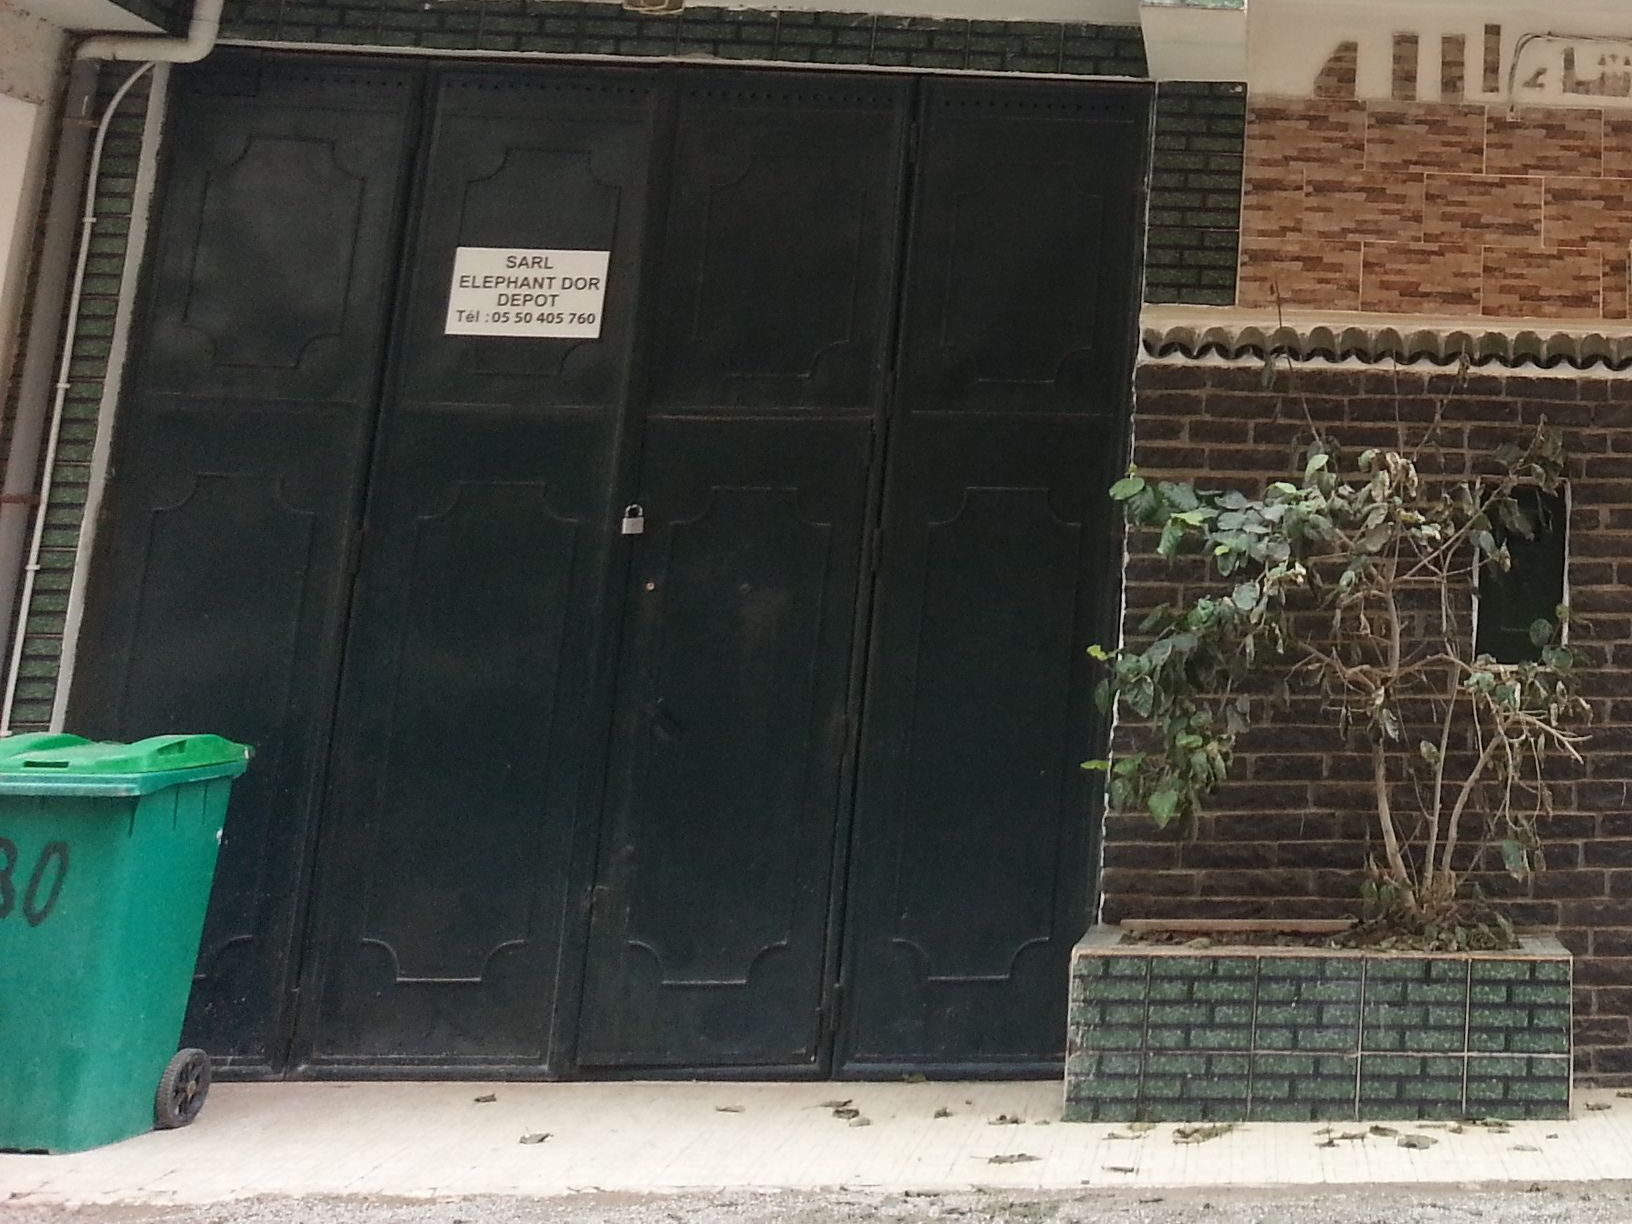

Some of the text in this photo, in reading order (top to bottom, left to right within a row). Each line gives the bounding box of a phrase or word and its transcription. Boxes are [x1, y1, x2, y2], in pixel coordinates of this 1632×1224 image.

[506, 256, 554, 269] SARL
[459, 275, 600, 291] ELEPHANT DOR
[497, 293, 559, 307] DEPOT
[514, 312, 533, 324] 50
[536, 313, 564, 324] 405
[568, 313, 596, 325] 760
